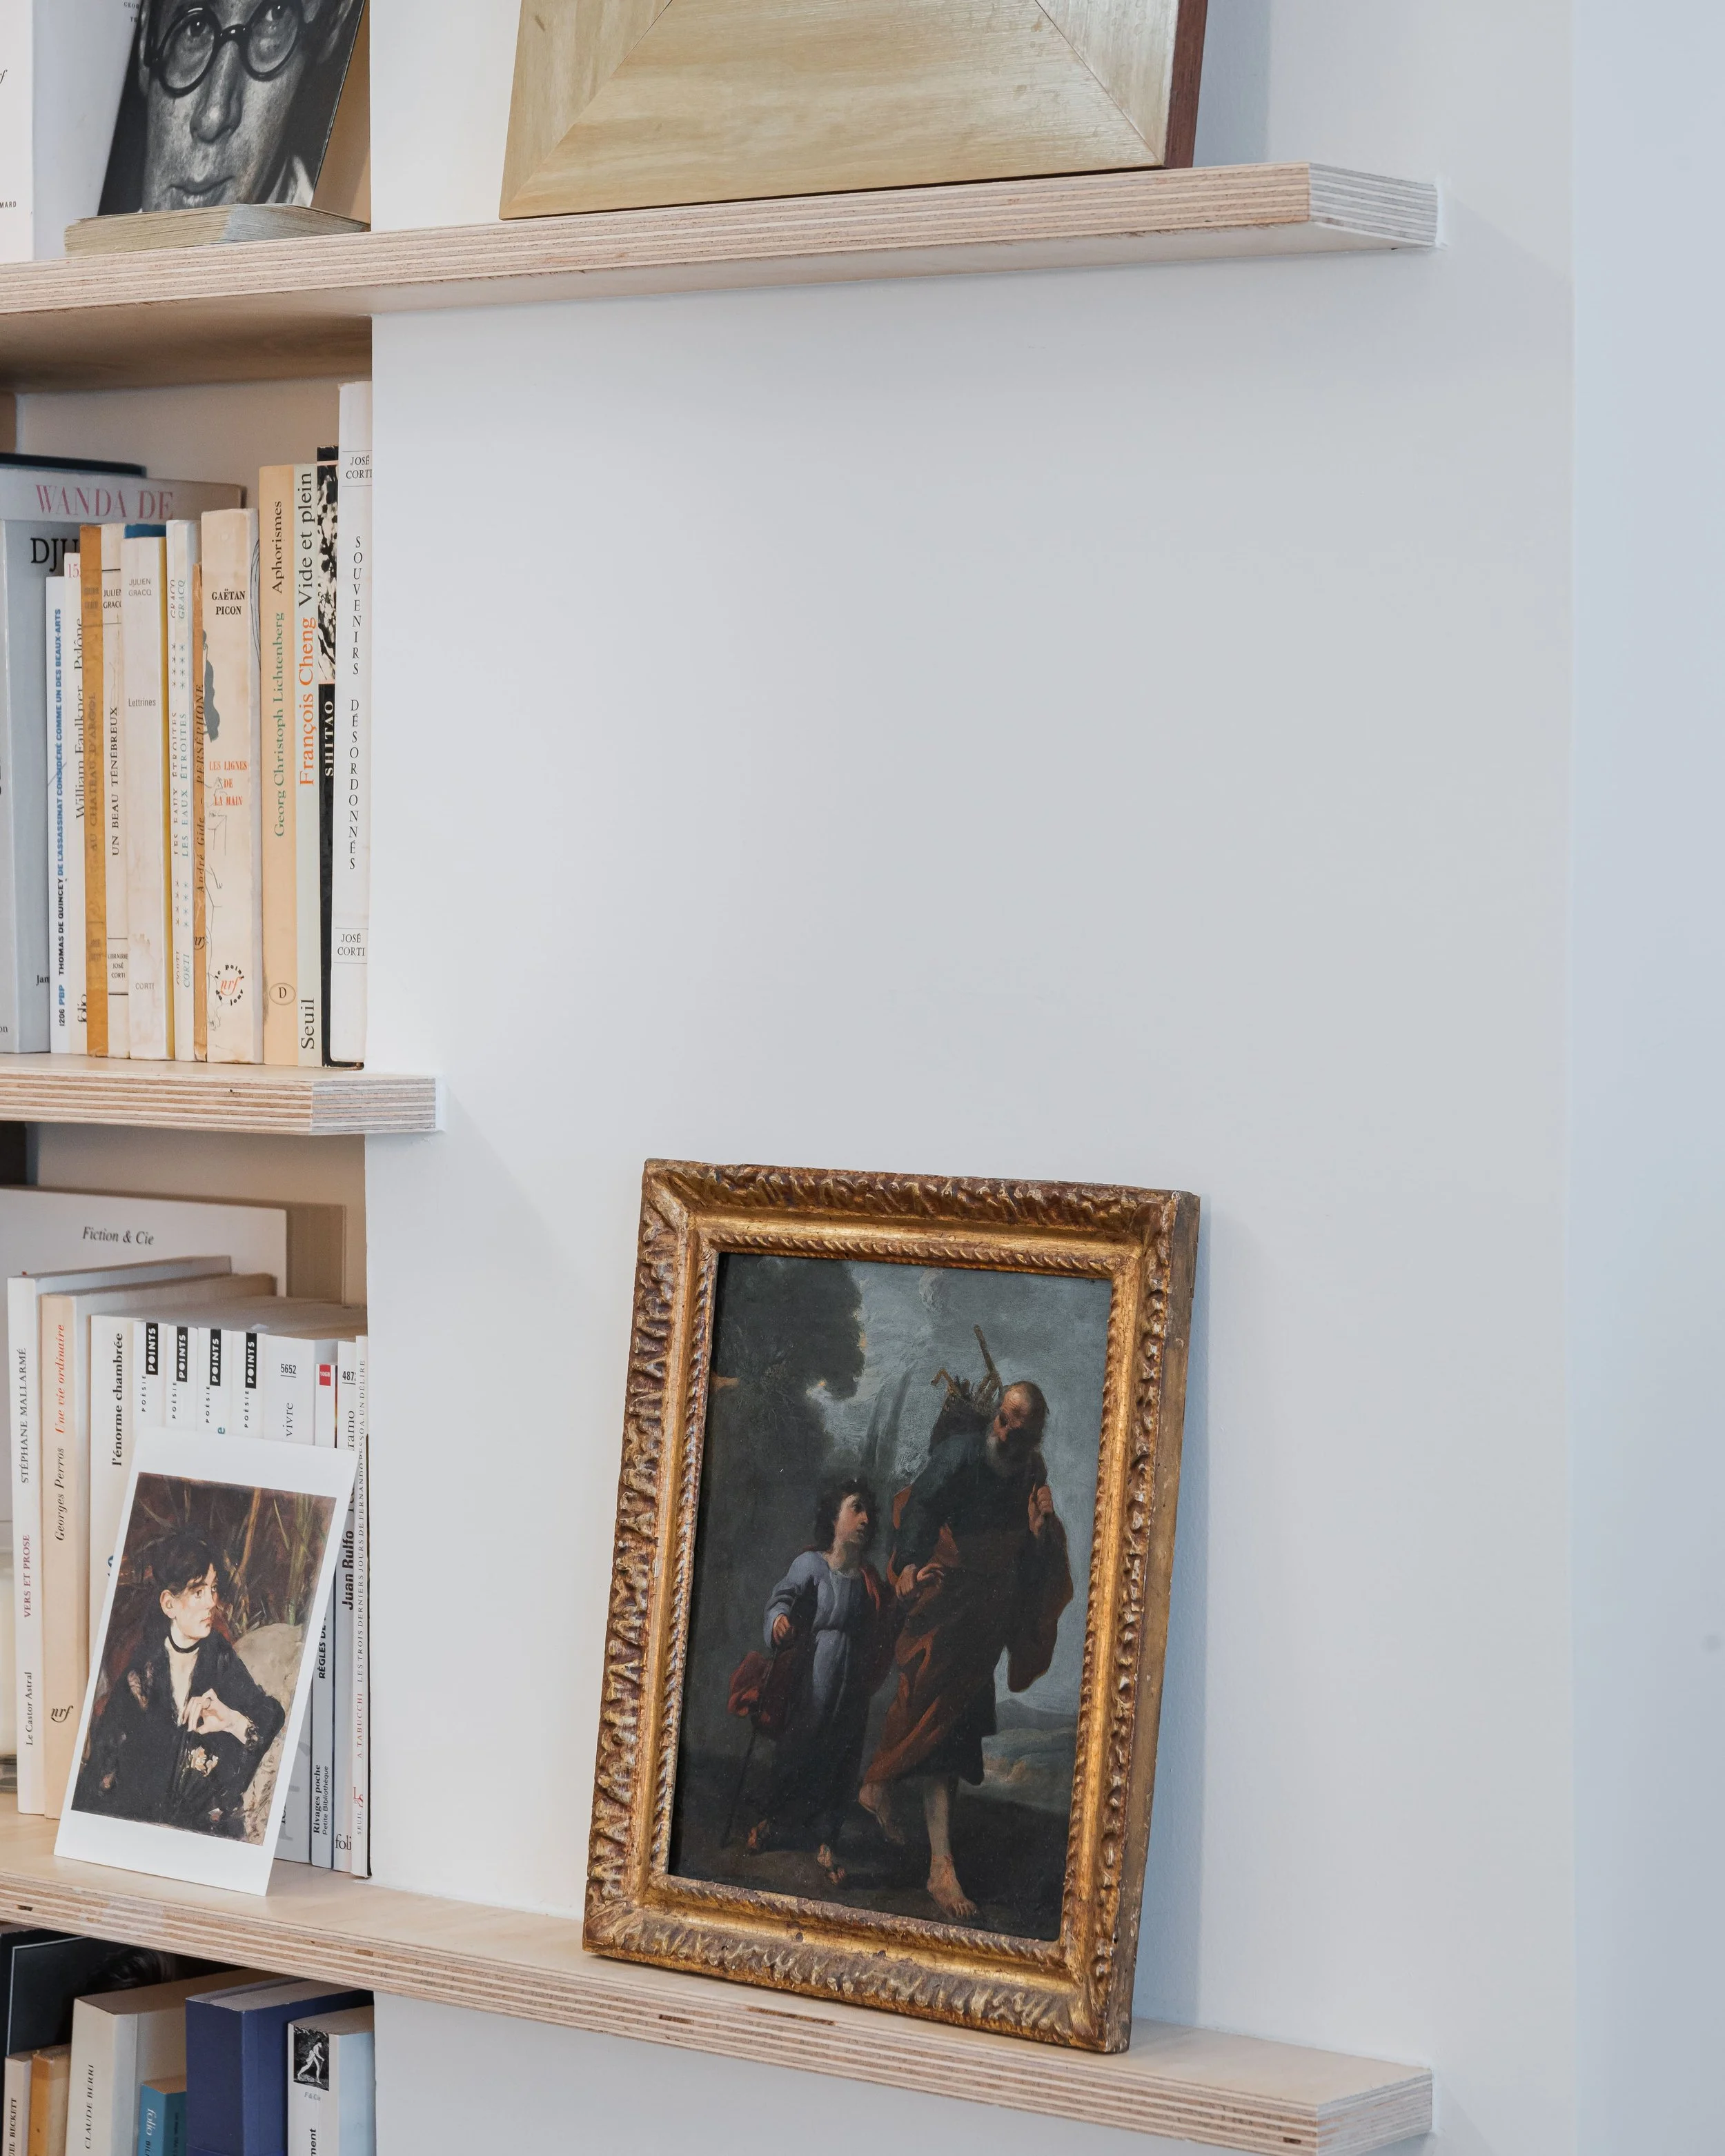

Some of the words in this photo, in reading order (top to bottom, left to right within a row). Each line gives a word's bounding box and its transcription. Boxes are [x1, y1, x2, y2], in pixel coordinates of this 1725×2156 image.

[346, 469, 372, 479] CORTI
[351, 455, 370, 466] JOSÉ
[35, 484, 127, 517] WANDA
[137, 490, 173, 520] DE
[297, 472, 315, 524] plein
[271, 501, 284, 594] Aphorismes
[300, 532, 313, 550] et
[128, 589, 152, 597] GRACQ
[129, 578, 151, 586] JULIEN
[212, 589, 246, 600] GAËTAN
[298, 557, 313, 608] Vide
[215, 606, 241, 615] PICON
[352, 536, 363, 675] SOUVENIRS
[273, 613, 285, 702] Lichtenberg
[299, 617, 316, 686] Cheng
[55, 690, 62, 703] UN
[128, 698, 156, 707] Lettrines
[75, 685, 84, 754] Faulkner
[195, 684, 205, 784] PERSÉPHONE
[110, 706, 119, 788] TÉNÉBREUX
[179, 713, 188, 779] ÉTROITES
[273, 709, 286, 787] Christoph
[299, 693, 317, 787] François
[324, 700, 334, 777] SHITAO
[55, 742, 63, 796] CONSIDÉRÉ
[209, 760, 221, 771] LES
[224, 760, 248, 771] LIGNES
[75, 760, 85, 819] William
[224, 778, 233, 789] DE
[226, 795, 243, 806] MAIN
[348, 700, 359, 870] DÉSORDONNÉS
[111, 793, 119, 829] BEAU
[274, 791, 286, 837] Georg
[112, 835, 119, 856] UN
[197, 817, 205, 845] Gide
[57, 862, 63, 876] DE
[197, 855, 205, 893] André
[58, 922, 64, 933] DE
[342, 933, 362, 943] JOSÉ
[337, 947, 366, 956] CORTI
[220, 976, 242, 996] nrf
[225, 965, 244, 980] point
[278, 987, 287, 999] D
[300, 998, 315, 1049] Seuil
[83, 1226, 119, 1242] Fiction
[122, 1229, 131, 1243] &
[136, 1231, 154, 1245] Cie
[55, 1325, 65, 1384] ordinaire
[112, 1333, 123, 1401] chambrée
[178, 1334, 186, 1378] POINTS
[280, 1363, 297, 1374] 5652
[16, 1347, 28, 1416] MALLARMÉ
[342, 1371, 356, 1381] 487
[55, 1387, 65, 1405] vie
[359, 1402, 365, 1416] UN
[55, 1410, 65, 1435] Une
[112, 1405, 122, 1466] l'énorme
[282, 1402, 293, 1437] vivre
[19, 1421, 29, 1483] STÉPHANE
[54, 1447, 65, 1490] Perros
[55, 1493, 68, 1541] Georges
[358, 1523, 364, 1536] DE
[22, 1535, 31, 1570] PROSE
[342, 1530, 354, 1569] Rulfo
[23, 1573, 31, 1587] ET
[342, 1574, 354, 1611] Juan
[317, 1641, 326, 1679] RÈGLES
[24, 1671, 32, 1700] Astral
[50, 1705, 74, 1723] nrf
[26, 1734, 33, 1745] Le
[313, 1764, 322, 1794] poche
[313, 1797, 322, 1834] Rivages
[9, 2097, 17, 2138] BECKETT
[146, 2108, 157, 2136] folio
